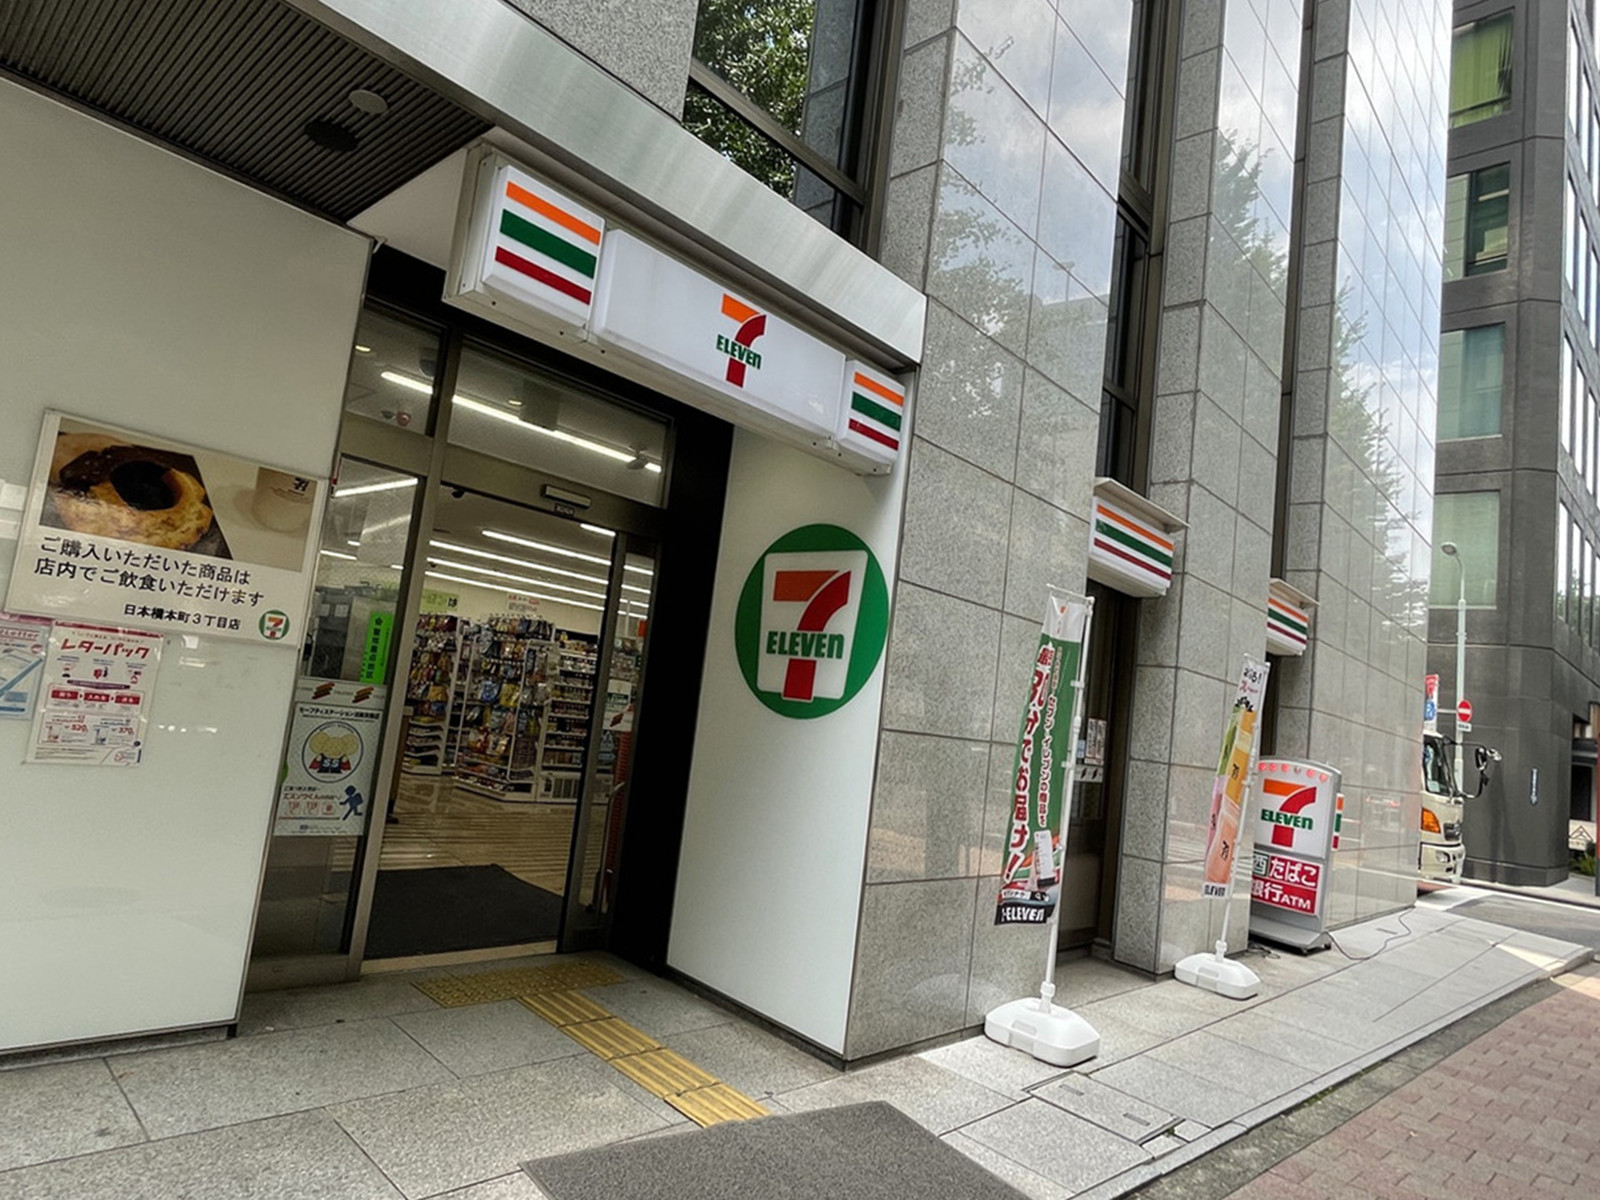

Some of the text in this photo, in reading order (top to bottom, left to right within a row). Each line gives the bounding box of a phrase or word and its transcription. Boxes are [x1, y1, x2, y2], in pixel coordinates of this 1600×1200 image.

[41, 536, 251, 585] ご購入いただいた商品は
[34, 557, 264, 607] 店内でご飲食いただけます
[61, 638, 150, 659] レターパック
[1270, 858, 1317, 887] たばこ
